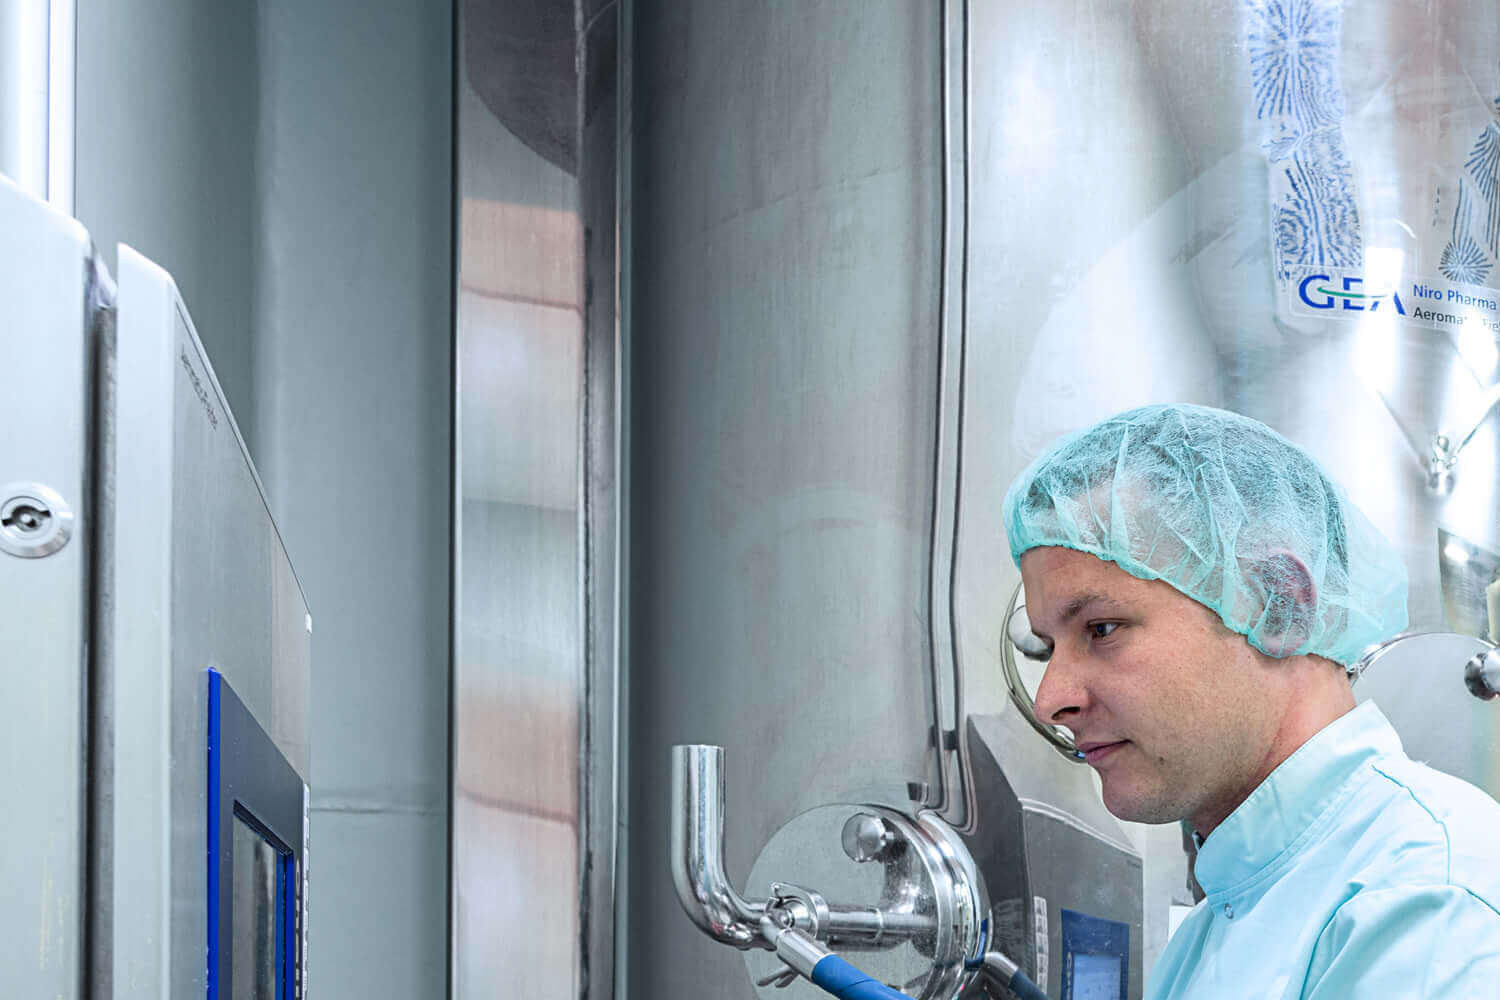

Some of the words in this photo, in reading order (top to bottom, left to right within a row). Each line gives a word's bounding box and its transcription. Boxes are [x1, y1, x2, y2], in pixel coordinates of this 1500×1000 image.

[1298, 274, 1406, 316] GEA
[1413, 284, 1443, 300] Niro
[1447, 291, 1497, 311] Pharma
